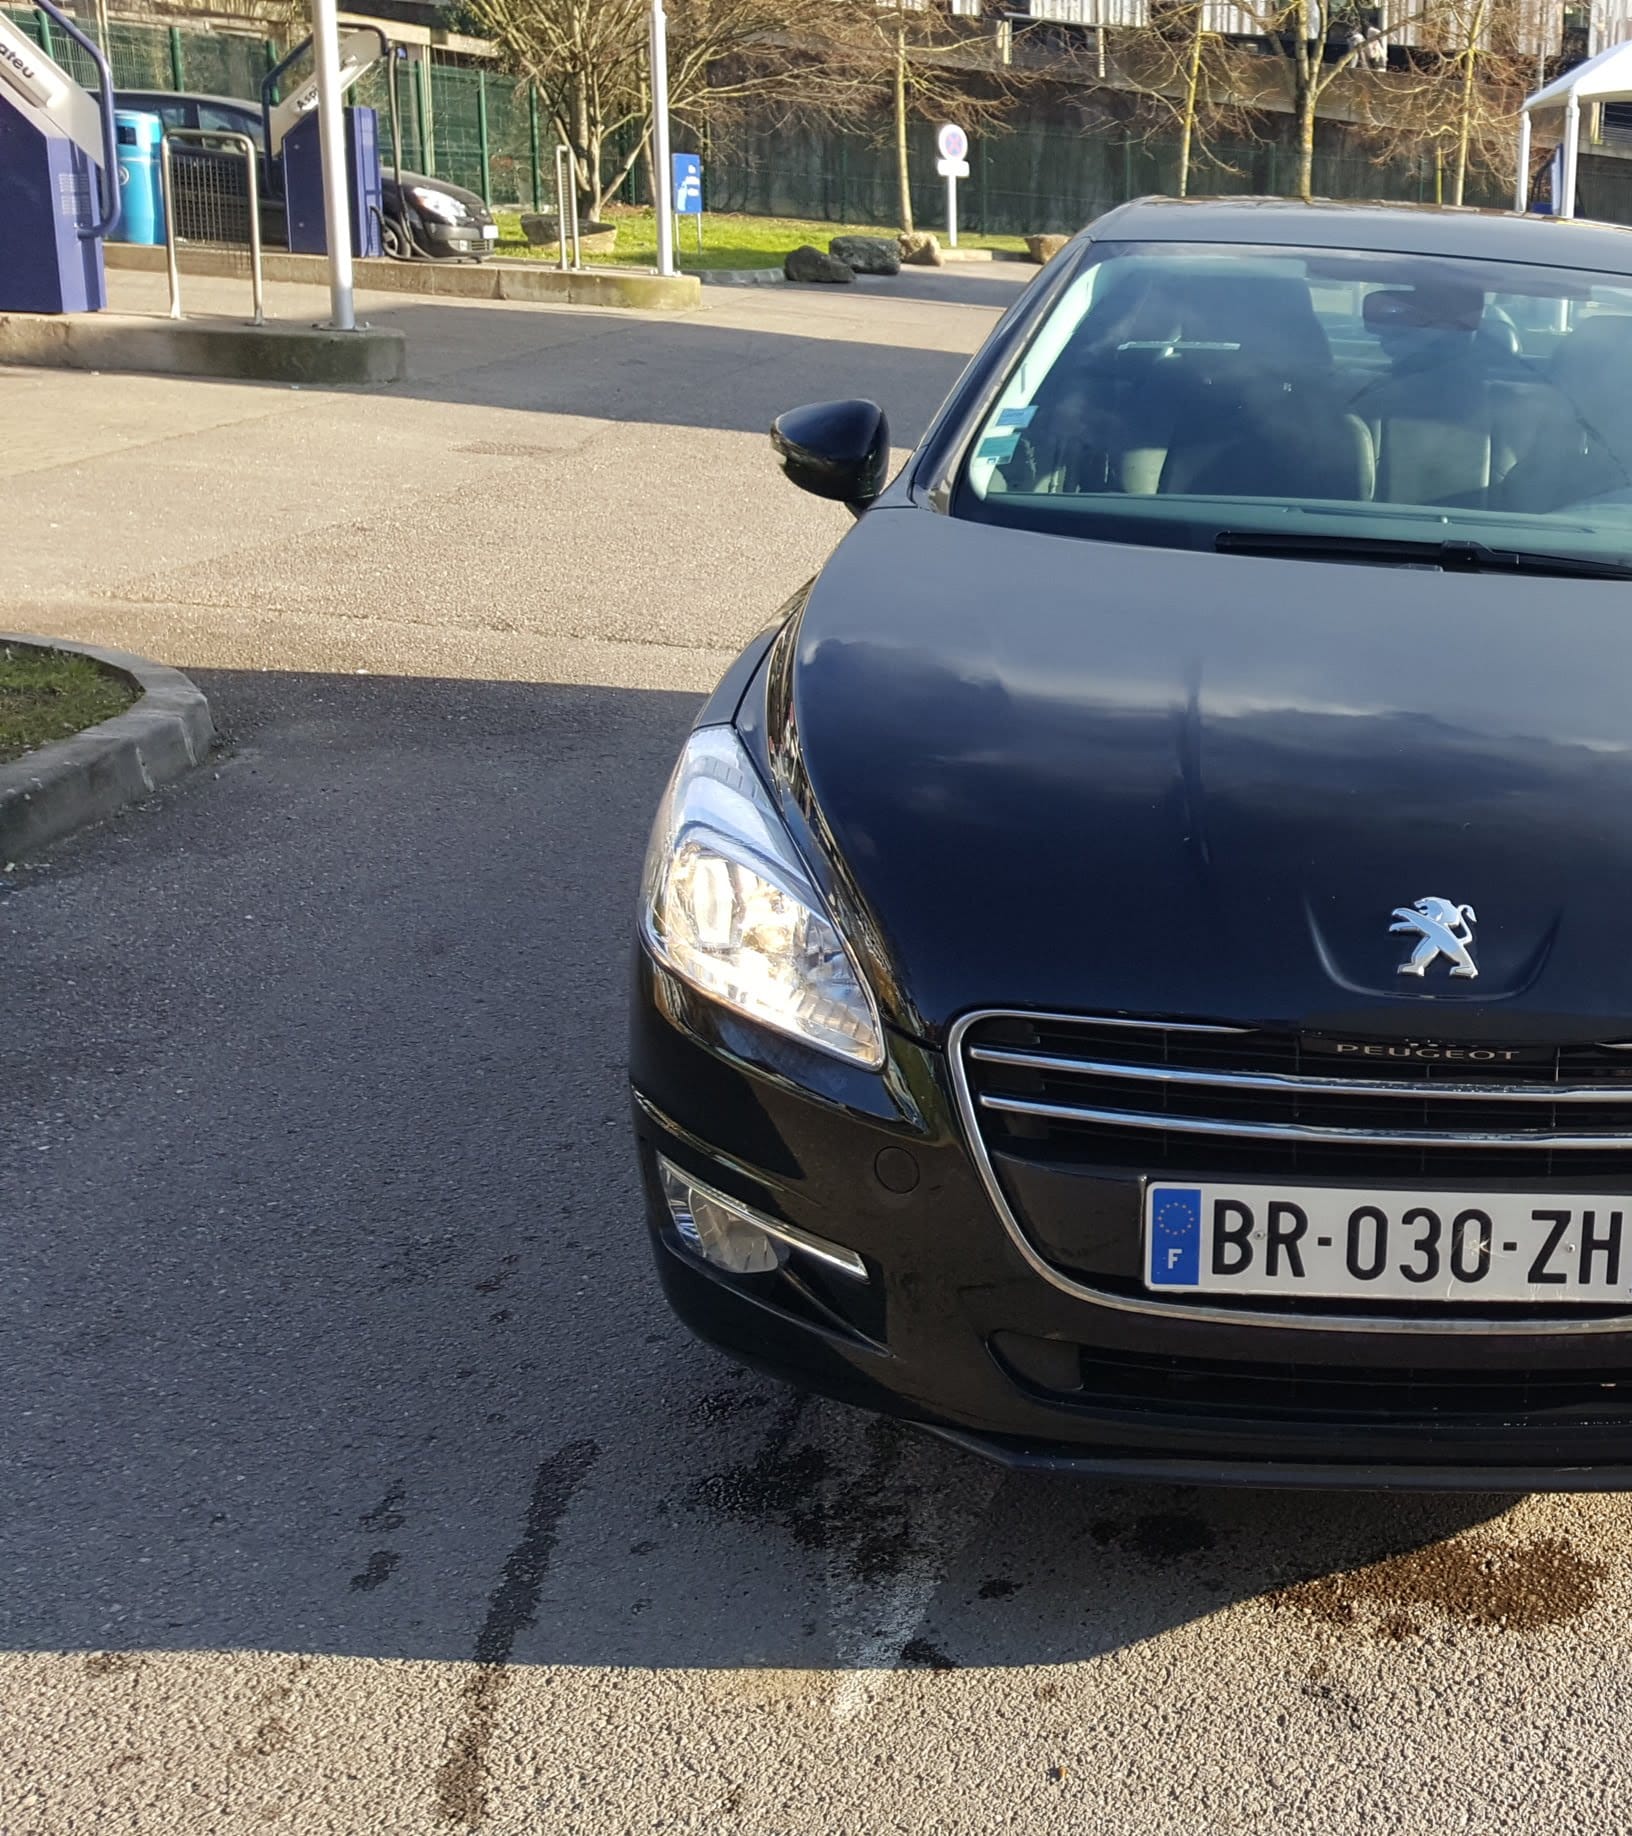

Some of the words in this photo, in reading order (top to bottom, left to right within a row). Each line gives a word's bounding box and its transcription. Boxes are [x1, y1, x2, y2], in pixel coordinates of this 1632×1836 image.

[1336, 1043, 1520, 1060] PEUGEOT
[1212, 1198, 1624, 1286] BR-030-ZH
[1167, 1248, 1183, 1269] F
